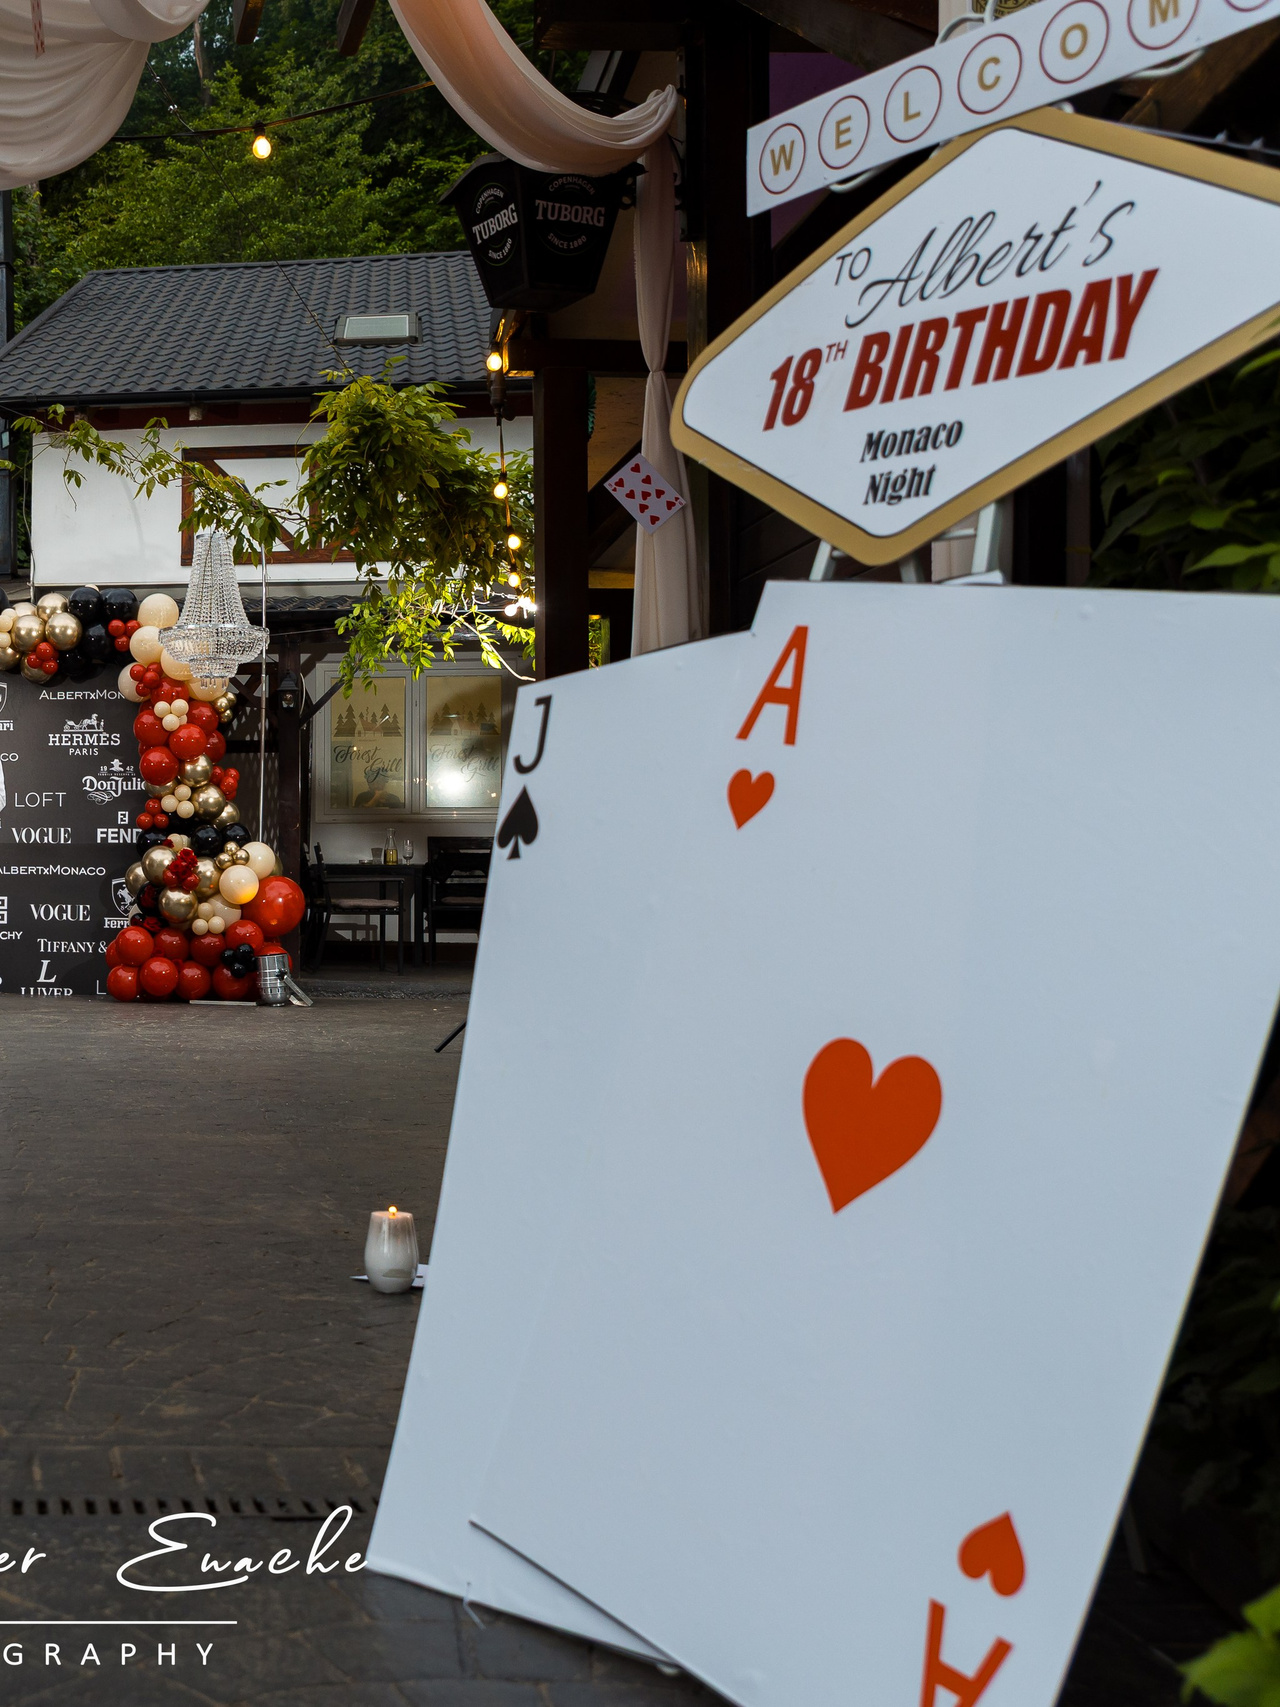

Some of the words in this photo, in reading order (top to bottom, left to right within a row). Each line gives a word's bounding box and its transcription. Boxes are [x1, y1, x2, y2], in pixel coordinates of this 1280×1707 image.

[769, 0, 1179, 177] WELCOM
[548, 176, 596, 195] COPENHAGEN
[475, 187, 505, 214] COPENHAGEN
[472, 203, 518, 245] TUBORG
[535, 199, 605, 227] TUBORG
[547, 233, 568, 249] SINCE
[569, 235, 587, 249] 1880
[488, 249, 503, 260] SINCE
[844, 180, 1138, 328] Albert's
[833, 247, 873, 286] TO
[843, 269, 1161, 412] BIRTHDAY
[859, 419, 963, 464] Monaco
[862, 466, 936, 508] Night
[39, 689, 126, 700] ALBERTxMON
[736, 625, 810, 747] A
[512, 694, 553, 774] J
[69, 748, 99, 756] PARIS
[333, 744, 380, 764] Forest
[429, 743, 477, 763] Forest
[363, 757, 403, 783] Grill
[461, 756, 500, 783] Grill
[14, 792, 67, 807] LOFT
[11, 827, 72, 844] VOGUE
[97, 828, 143, 843] FEND
[30, 904, 91, 921] VOGUE
[103, 917, 130, 929] Ferr
[37, 938, 96, 953] TIFFANY
[98, 941, 108, 953] &
